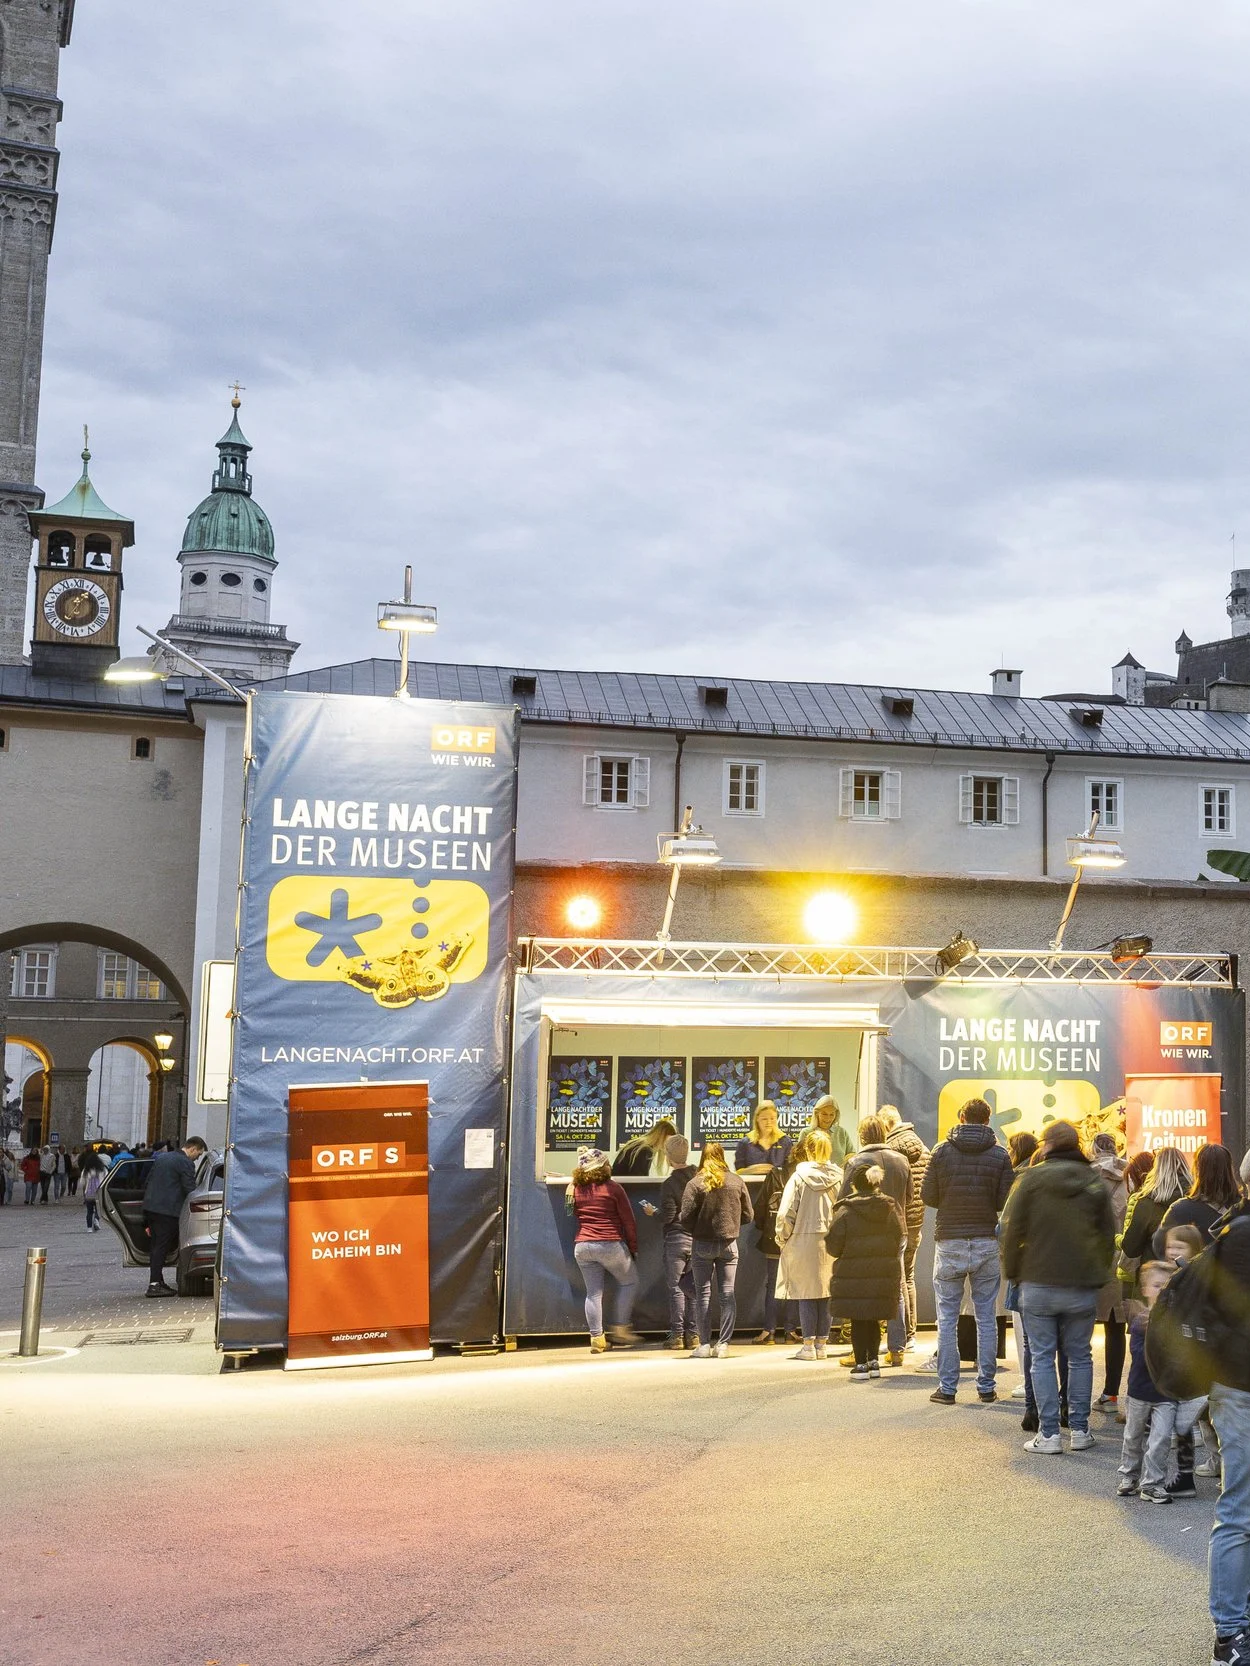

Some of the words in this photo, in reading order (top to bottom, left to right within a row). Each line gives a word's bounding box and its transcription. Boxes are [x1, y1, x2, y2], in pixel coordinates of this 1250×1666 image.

[437, 730, 492, 748] ORF
[430, 754, 459, 766] WIE
[463, 756, 495, 768] WIR.
[272, 798, 379, 831] LANGE
[388, 802, 493, 834] NACHT
[271, 834, 336, 866] DER
[350, 837, 492, 871] MUSEEN
[940, 1018, 1016, 1042] LANGE
[1024, 1020, 1100, 1042] NACHT
[1164, 1026, 1208, 1040] ORF
[262, 1046, 484, 1064] LANGENACHT.ORF.AT
[940, 1046, 986, 1071] DER
[997, 1047, 1100, 1072] MUSEEN
[1160, 1049, 1182, 1058] WIE
[1186, 1048, 1212, 1058] WIR.
[550, 1113, 602, 1128] MUSEEN
[625, 1113, 676, 1128] MUSEN
[700, 1113, 750, 1127] MUSEEN
[777, 1113, 812, 1127] USEE
[1142, 1105, 1206, 1128] Kronen
[317, 1148, 374, 1167] ORF
[385, 1147, 399, 1164] S
[312, 1231, 339, 1243] WO
[344, 1229, 370, 1241] ICH
[312, 1246, 371, 1260] DAHEIM
[376, 1244, 401, 1256] BIN
[332, 1332, 388, 1341] salzburg.ORF.at
